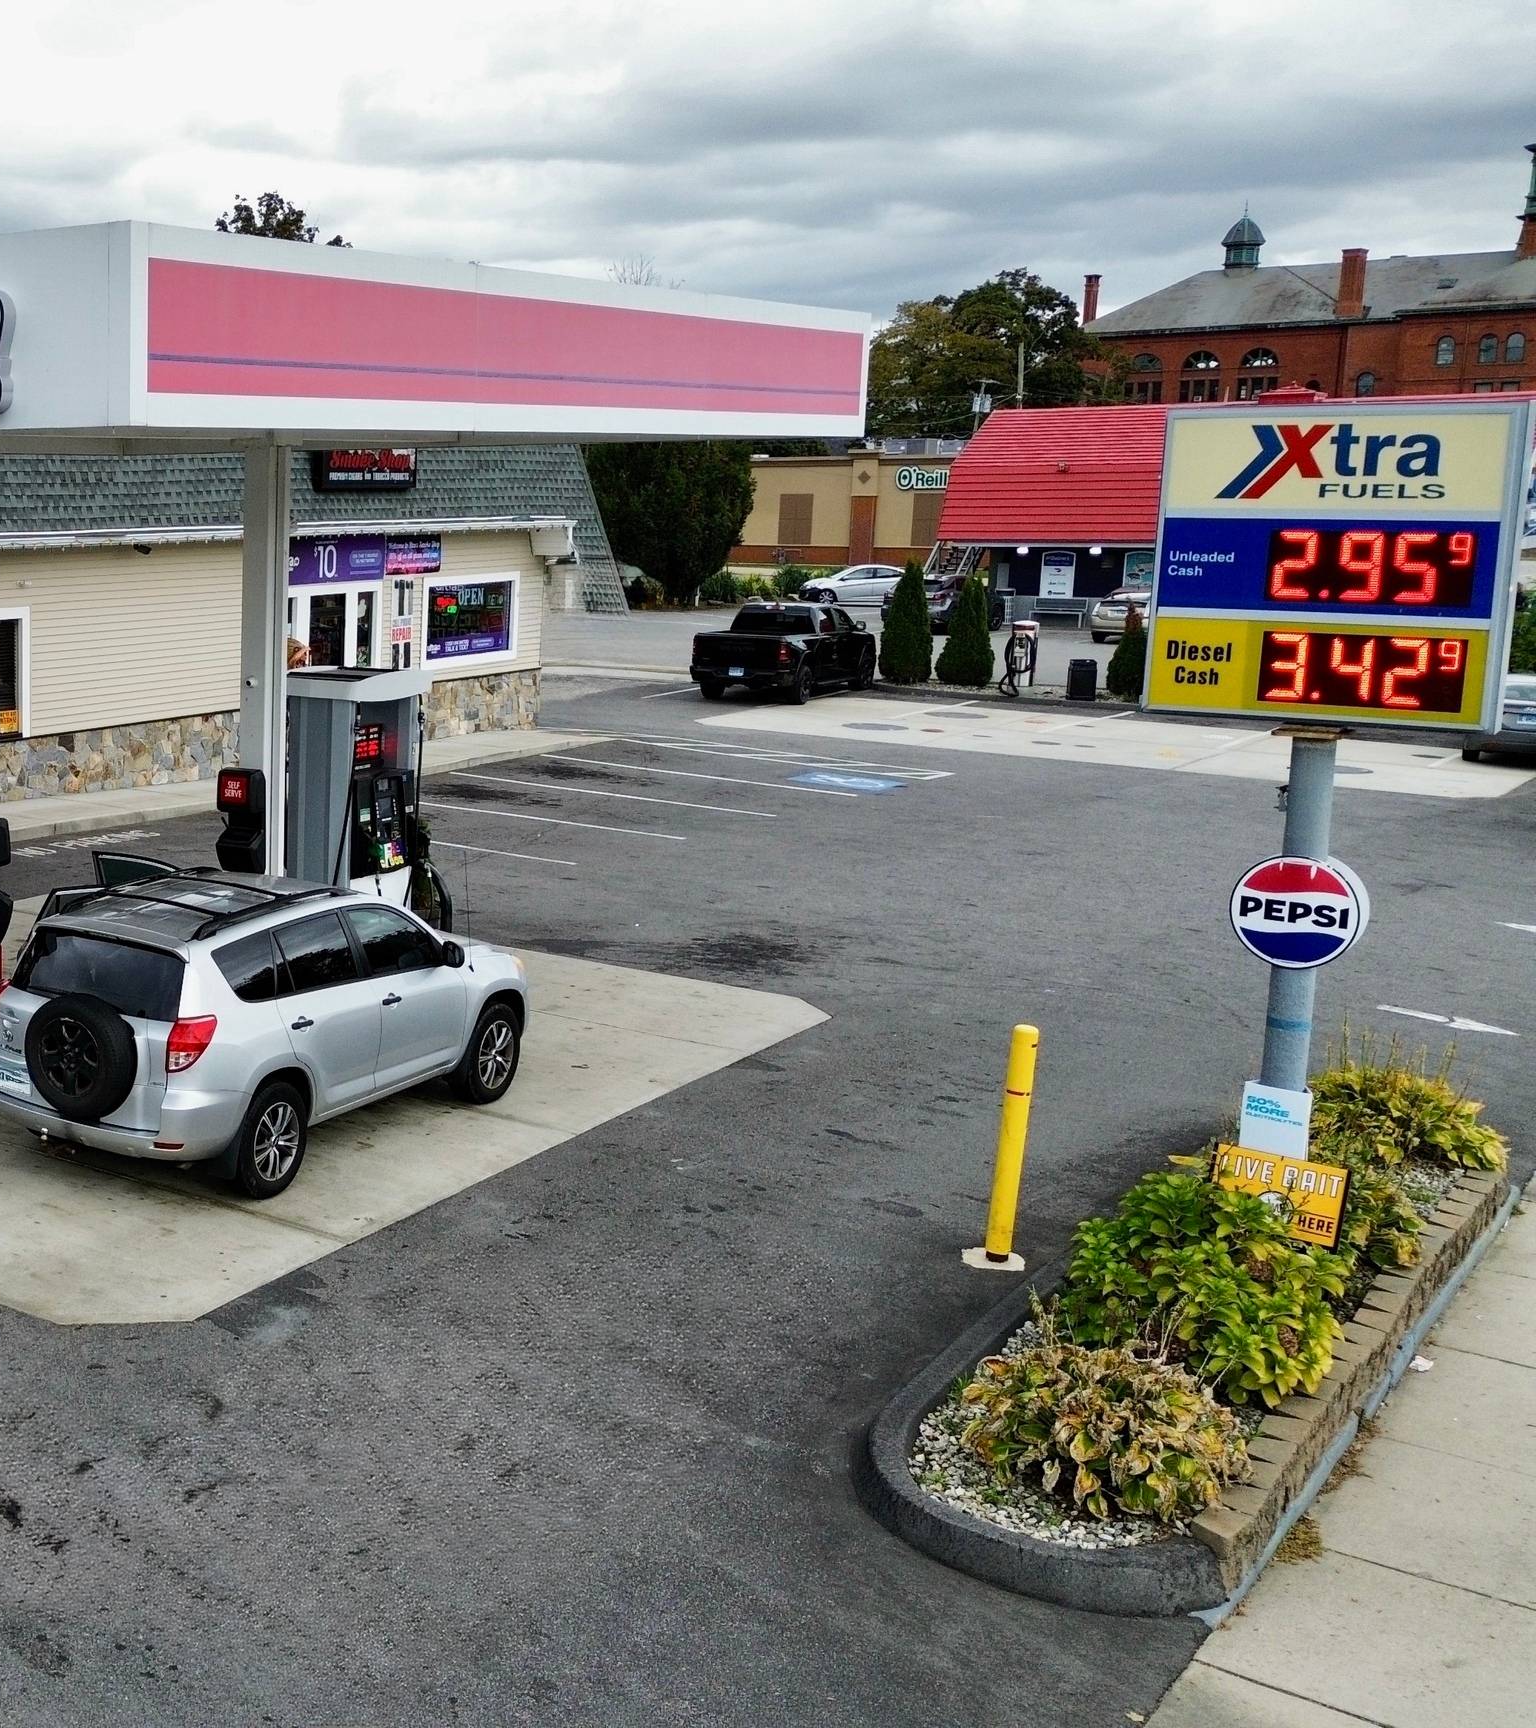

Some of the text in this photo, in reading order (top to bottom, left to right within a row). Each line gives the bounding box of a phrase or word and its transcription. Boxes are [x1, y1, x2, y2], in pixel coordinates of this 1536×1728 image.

[329, 448, 410, 470] Smoke Shop
[1226, 423, 1441, 499] Xtra
[897, 468, 947, 488] O'Reill
[1318, 483, 1446, 500] FUELS
[314, 545, 337, 579] $10
[1169, 550, 1235, 564] Unleaded
[1270, 530, 1439, 603] 2.95
[1167, 564, 1203, 577] Cash
[458, 587, 485, 606] OPEN
[392, 627, 412, 641] REPAIR
[1166, 640, 1233, 663] Diesel
[1174, 666, 1219, 686] Cash
[1264, 632, 1431, 707] 3.42
[224, 788, 243, 799] SERVE
[227, 781, 241, 790] SELF
[11, 829, 161, 858] NO PARKING
[1239, 895, 1350, 930] PEPSI
[1246, 1102, 1291, 1118] MORE
[1247, 1095, 1281, 1109] 50%
[1282, 1164, 1344, 1198] BAIT
[1298, 1214, 1334, 1234] HERE
